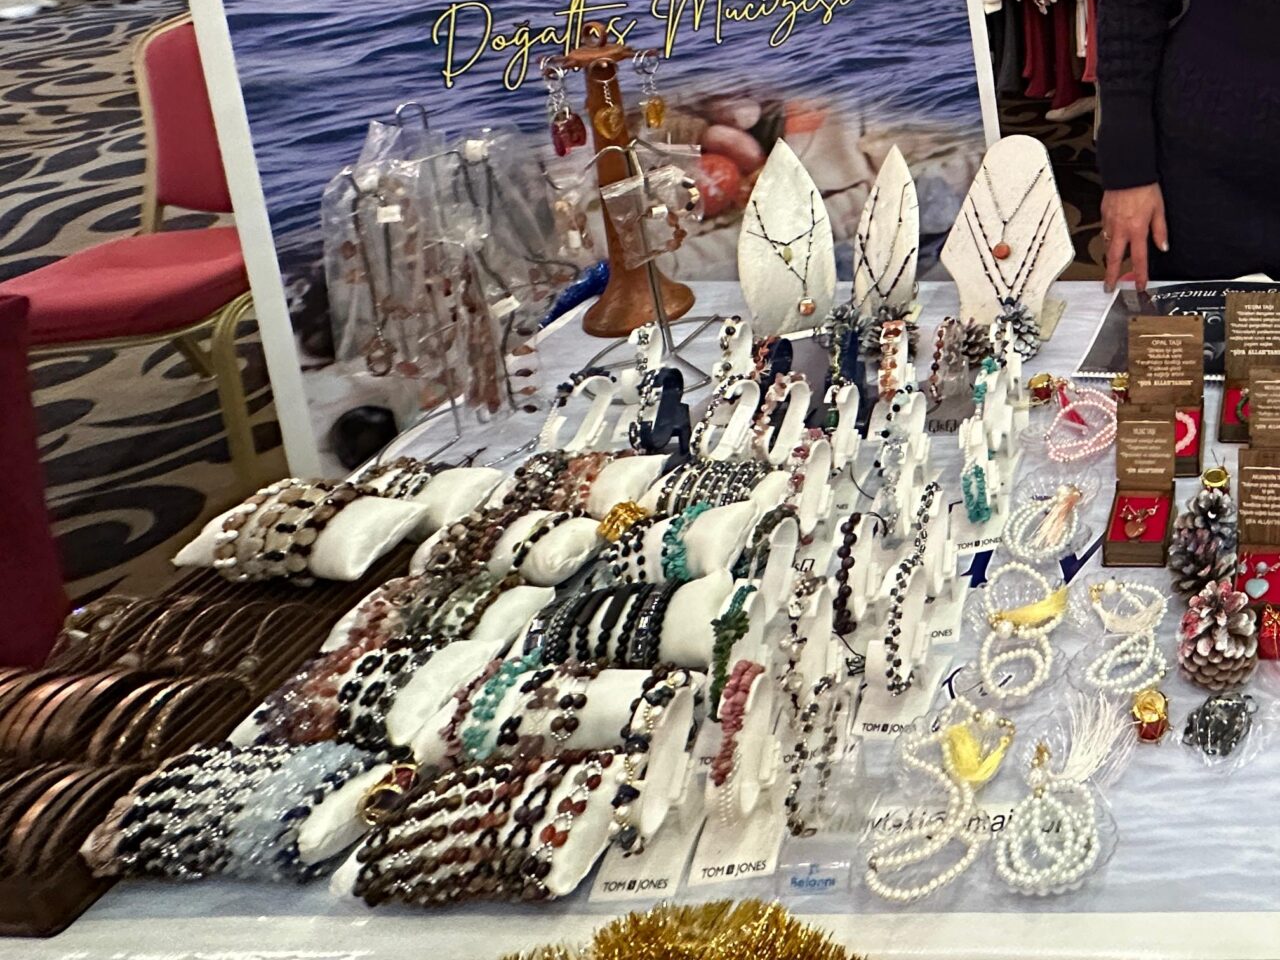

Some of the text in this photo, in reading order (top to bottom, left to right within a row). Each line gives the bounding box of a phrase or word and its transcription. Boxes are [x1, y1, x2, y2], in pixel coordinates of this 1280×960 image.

[957, 542, 975, 550] TOM
[862, 722, 880, 732] TOM
[702, 860, 767, 878] TOM JONES
[603, 878, 669, 894] TOM JONES
